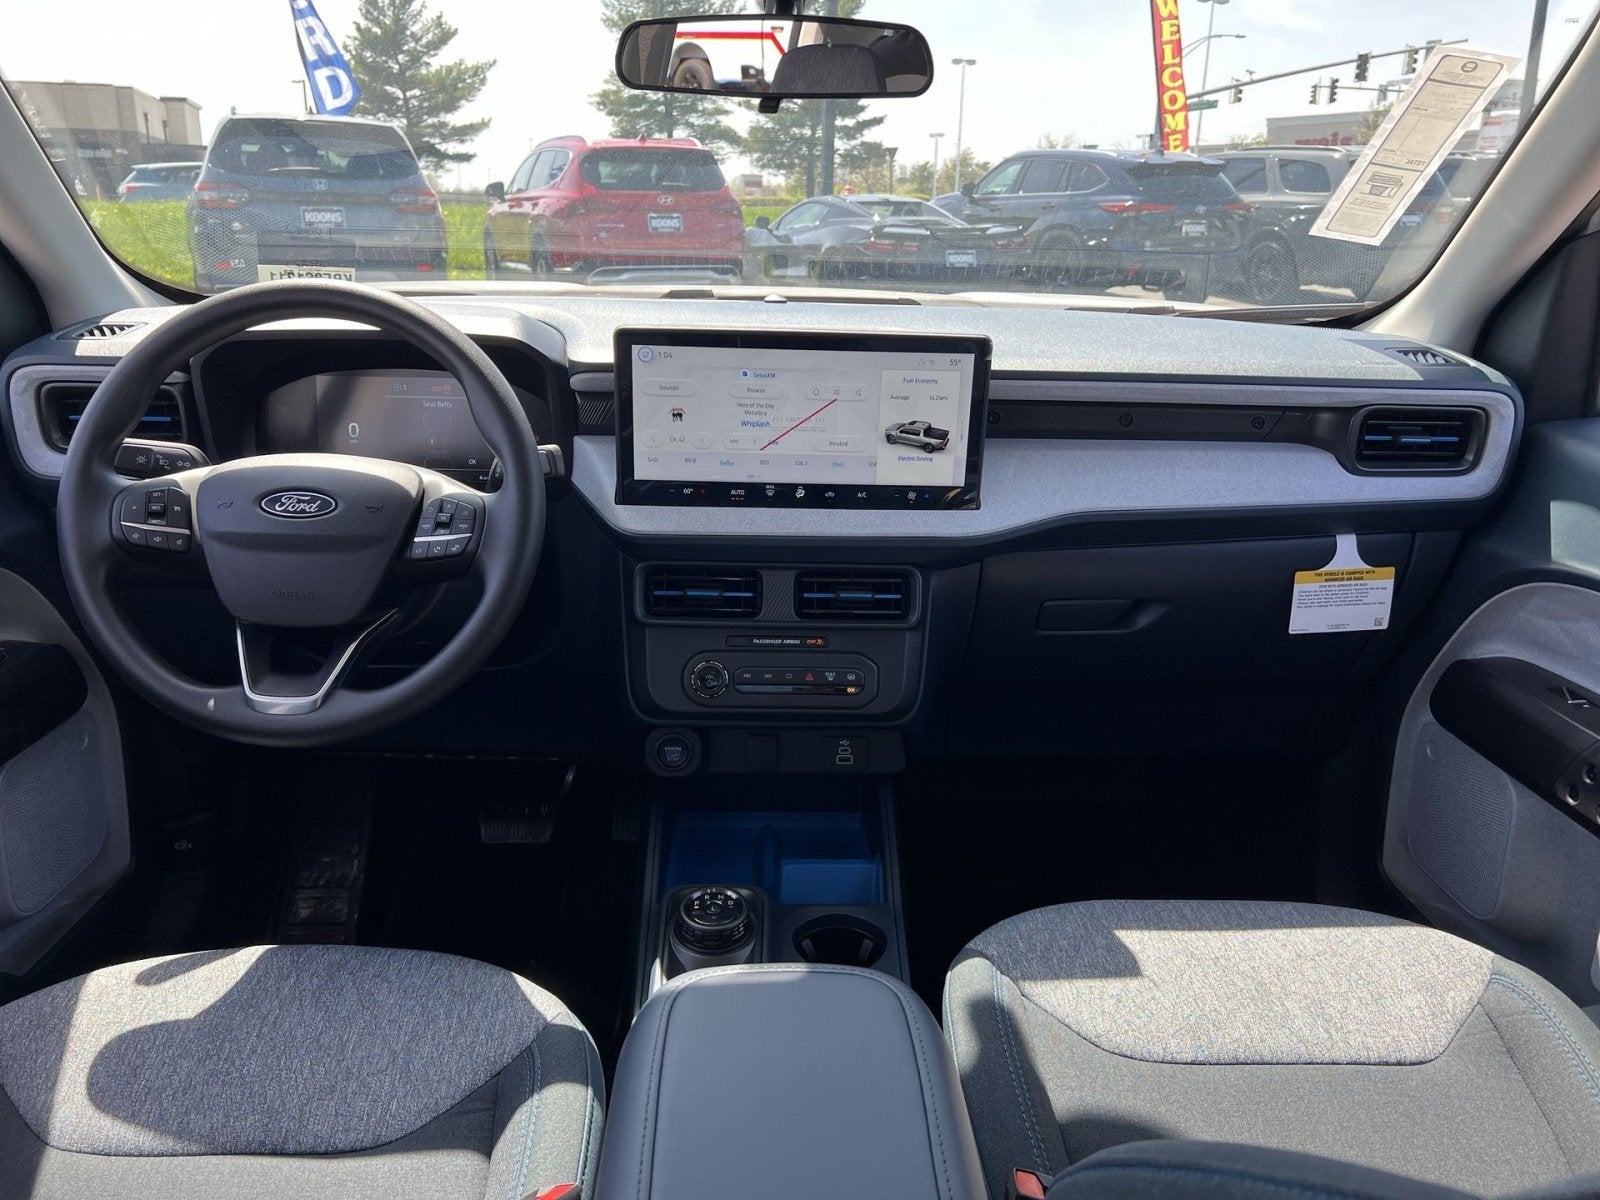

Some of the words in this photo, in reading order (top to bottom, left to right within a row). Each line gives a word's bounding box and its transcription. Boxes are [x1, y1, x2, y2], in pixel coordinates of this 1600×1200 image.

[293, 0, 353, 111] RD
[1154, 0, 1187, 153] WELCOME
[304, 211, 343, 223] KOONS
[657, 351, 673, 359] 1:04
[753, 371, 776, 379] SiriusXM
[915, 377, 938, 385] Economy
[746, 386, 765, 394] Browse
[741, 420, 770, 428] Whiplash
[348, 422, 360, 438] 0
[275, 494, 322, 512] Ford
